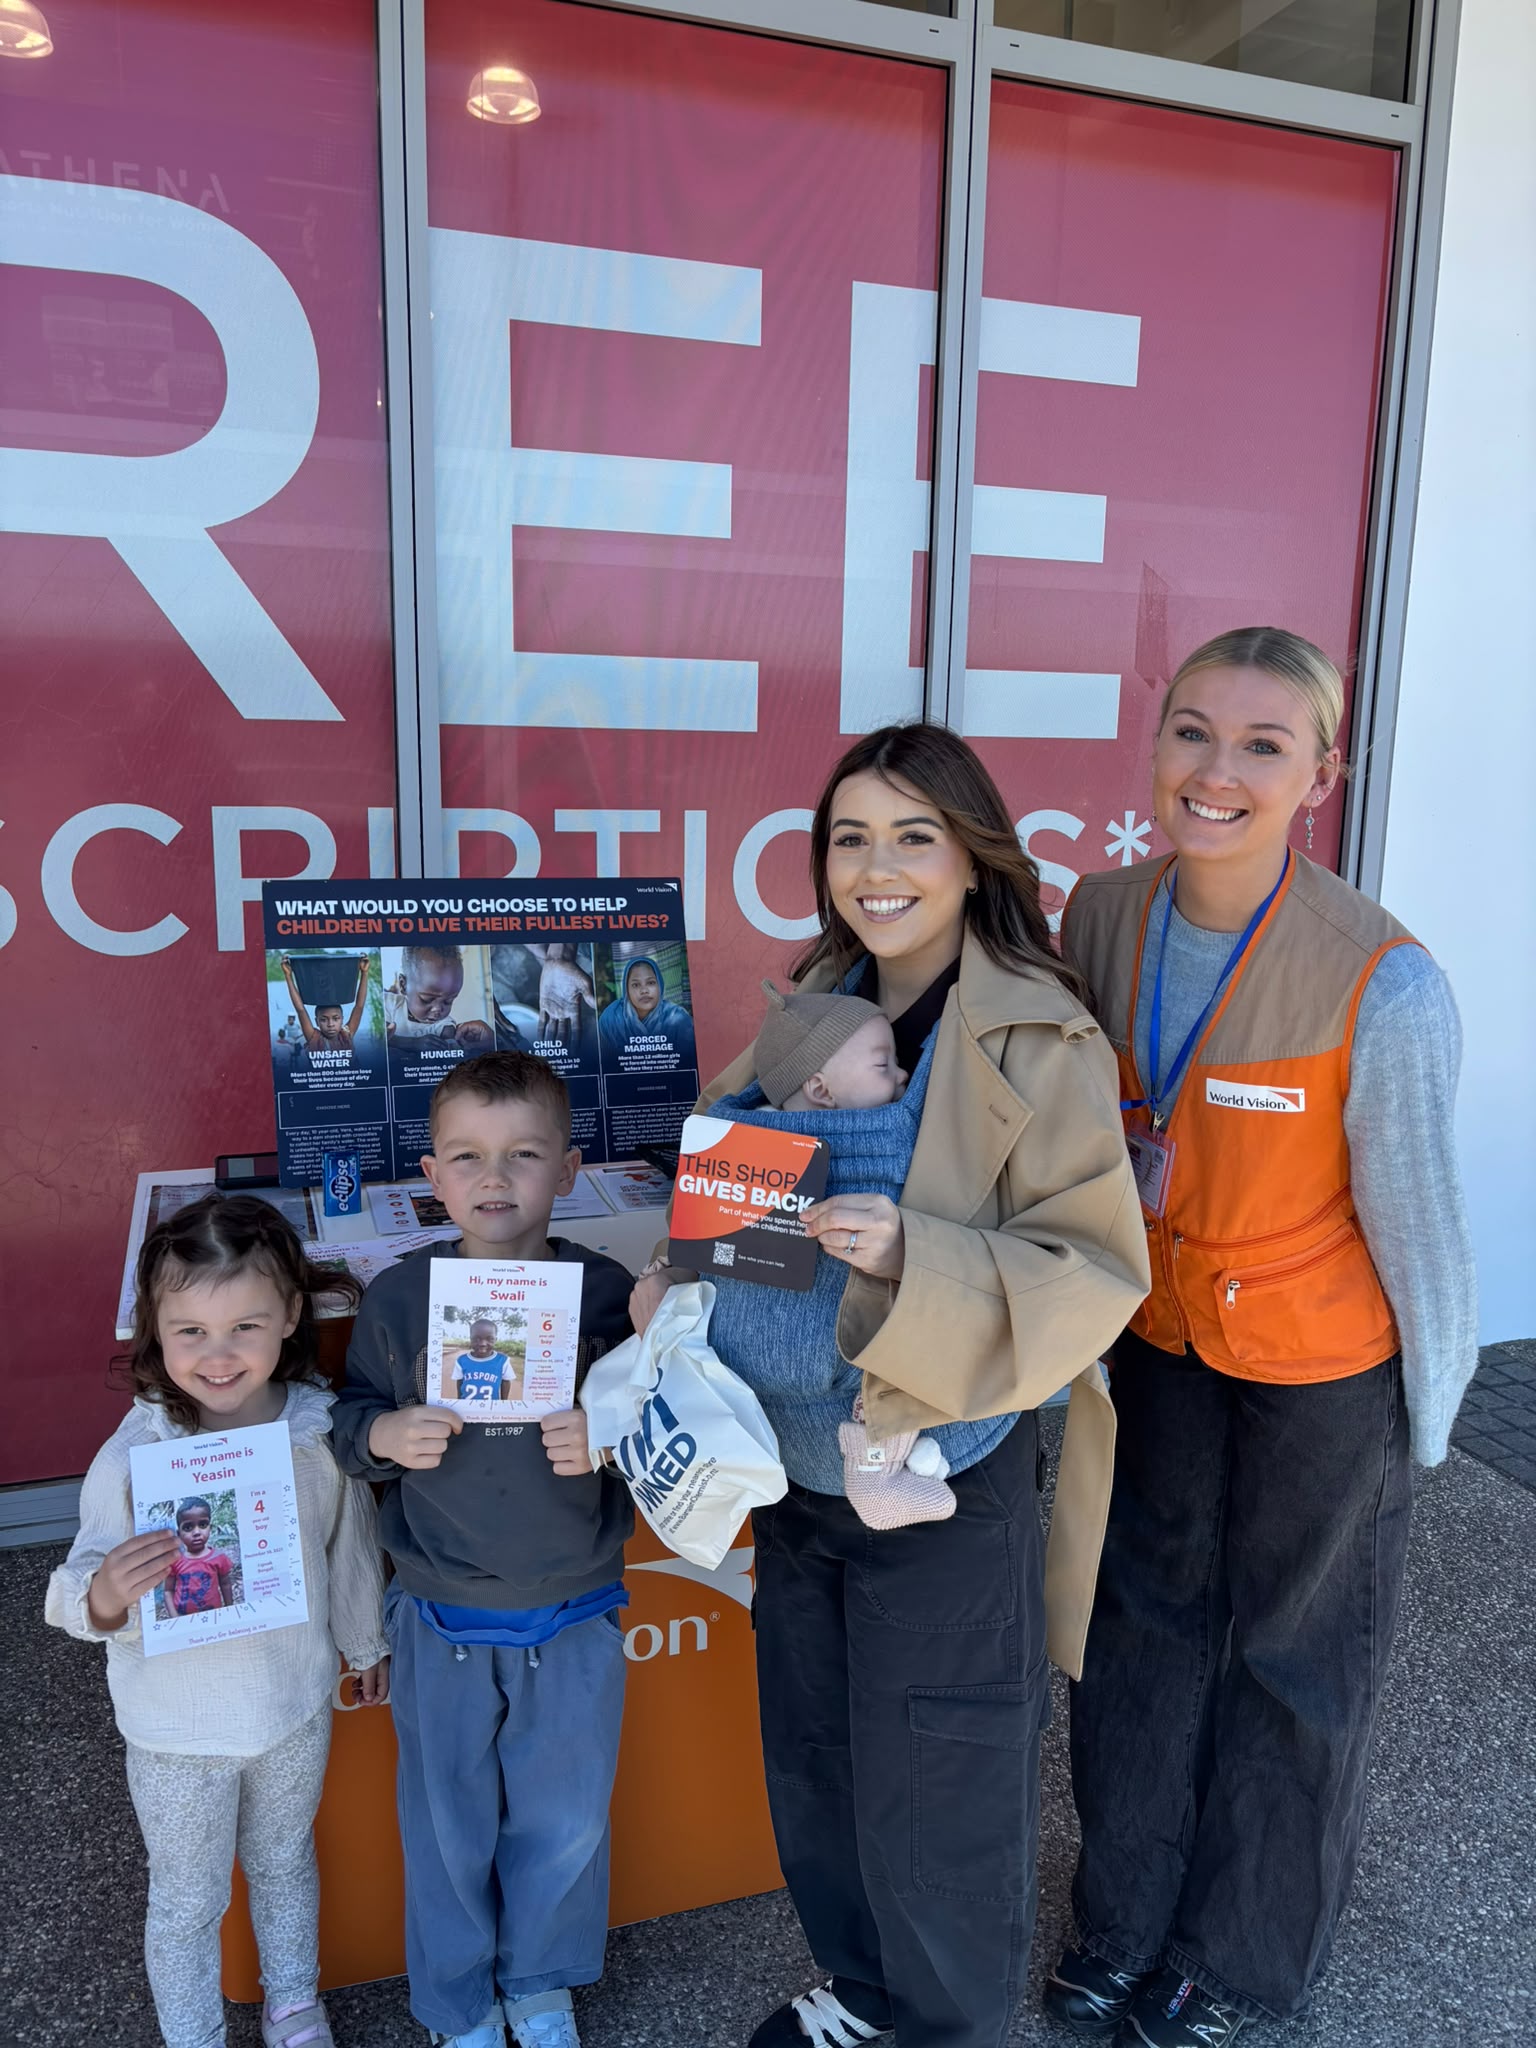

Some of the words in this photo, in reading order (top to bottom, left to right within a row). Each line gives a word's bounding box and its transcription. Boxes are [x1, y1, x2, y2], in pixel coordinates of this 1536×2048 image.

[275, 900, 338, 916] WHAT
[342, 900, 418, 915] WOULD
[422, 899, 463, 914] YOU
[467, 898, 548, 914] CHOOSE
[552, 898, 578, 912] TO
[581, 897, 628, 912] HELP
[276, 918, 382, 935] CHILDREN
[386, 918, 414, 933] TO
[418, 918, 461, 932] LIVE
[464, 916, 522, 932] THEIR
[526, 915, 605, 931] FULLEST
[608, 914, 669, 929] LIVES?
[533, 1040, 562, 1048] CHILD
[630, 1035, 667, 1044] FORCED
[309, 1050, 352, 1060] UNSAFE
[421, 1050, 464, 1059] HUNGER
[624, 1043, 674, 1052] MARRIAGE
[312, 1059, 350, 1068] WATER
[1209, 1091, 1244, 1106] World
[1247, 1098, 1287, 1110] Vision
[683, 1154, 731, 1179] THIS
[736, 1164, 797, 1190] SHOP
[335, 1159, 352, 1212] eclipse
[678, 1174, 746, 1202] GIVES
[751, 1186, 815, 1214] BACK
[719, 1206, 733, 1215] Part
[742, 1211, 760, 1220] what
[774, 1217, 796, 1226] spend
[742, 1219, 759, 1229] helps
[760, 1222, 788, 1233] children
[469, 1275, 484, 1286] Hi,
[487, 1278, 504, 1287] my
[539, 1277, 547, 1286] is
[490, 1290, 525, 1301] Swali
[543, 1319, 552, 1331] 6
[473, 1371, 498, 1383] SPORT
[465, 1384, 494, 1400] 23
[171, 1458, 187, 1469] Hi,
[190, 1456, 207, 1467] my
[210, 1450, 242, 1462] name
[244, 1447, 254, 1456] is
[192, 1467, 236, 1483] Yeasin
[254, 1499, 265, 1513] 4
[673, 1499, 684, 1513] find
[680, 1490, 691, 1503] your
[178, 1571, 212, 1615] R
